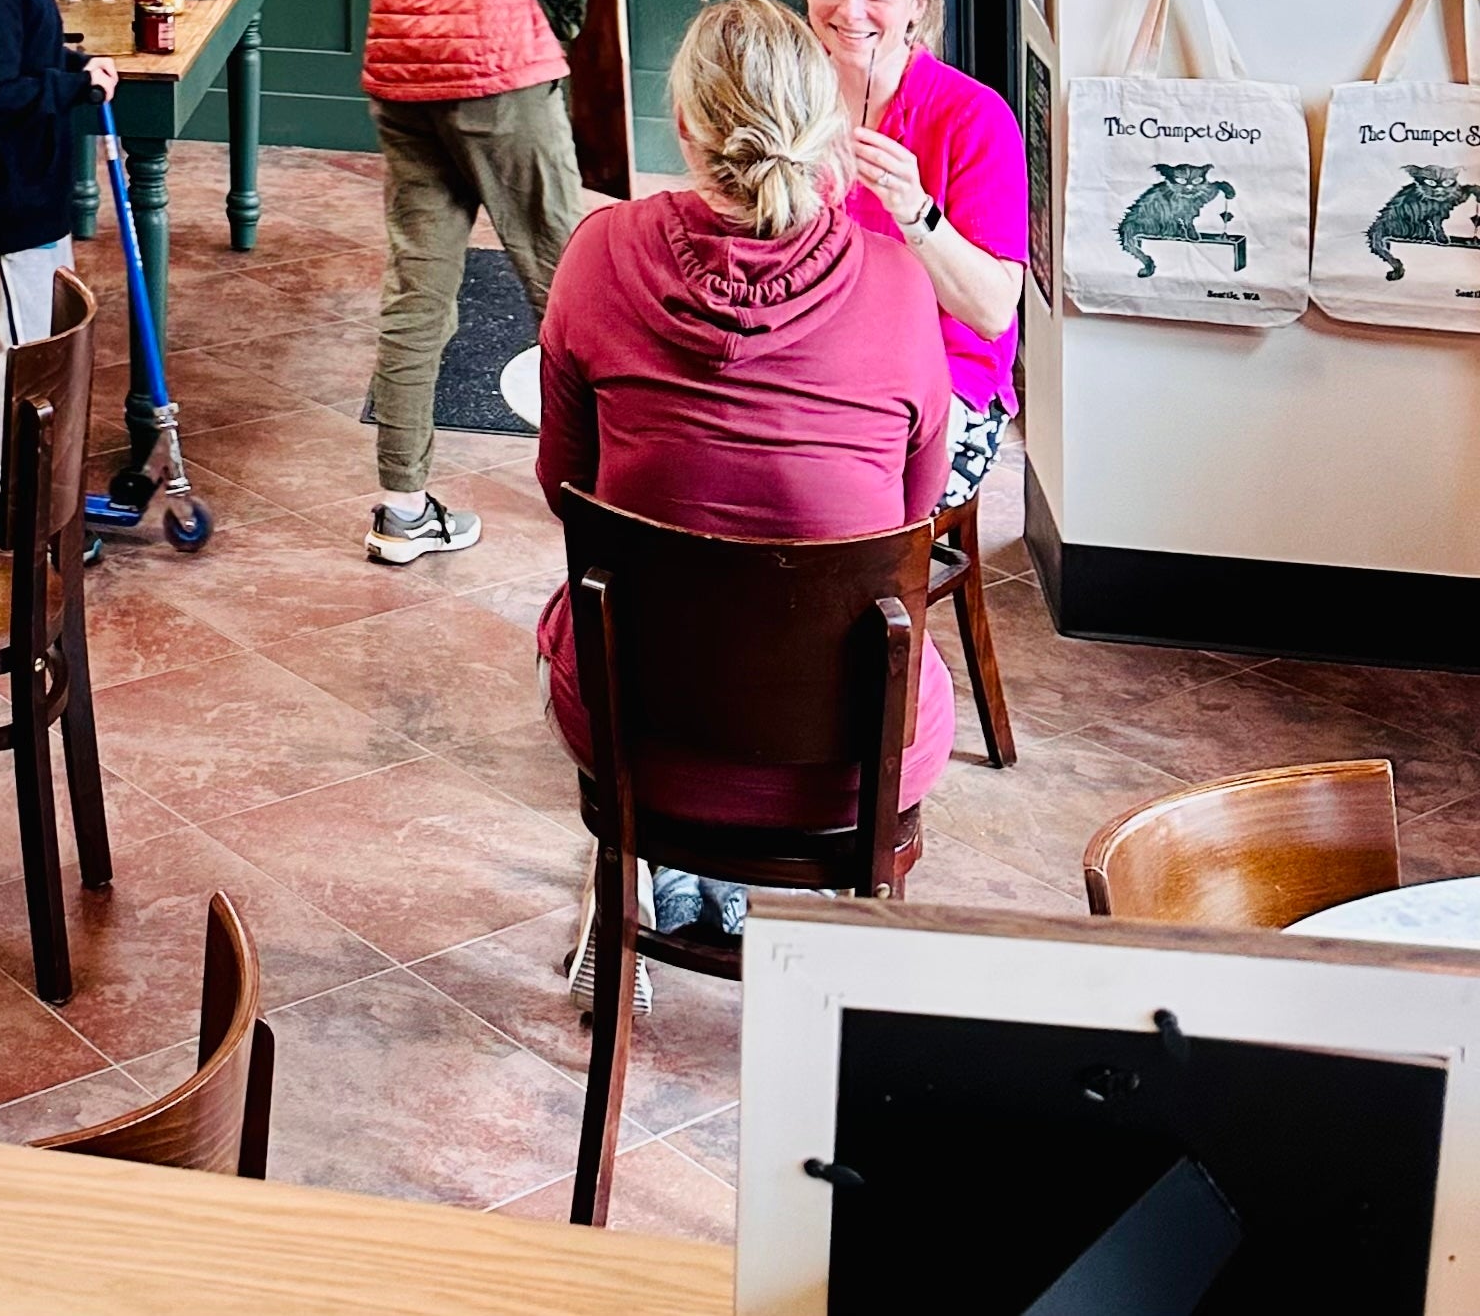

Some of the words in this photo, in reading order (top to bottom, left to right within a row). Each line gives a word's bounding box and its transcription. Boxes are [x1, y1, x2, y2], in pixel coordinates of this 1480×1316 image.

[1103, 116, 1137, 137] The
[1139, 117, 1214, 143] Crumpet
[1215, 120, 1262, 145] Shop
[1359, 124, 1386, 144] The
[1389, 121, 1464, 147] Crumpet
